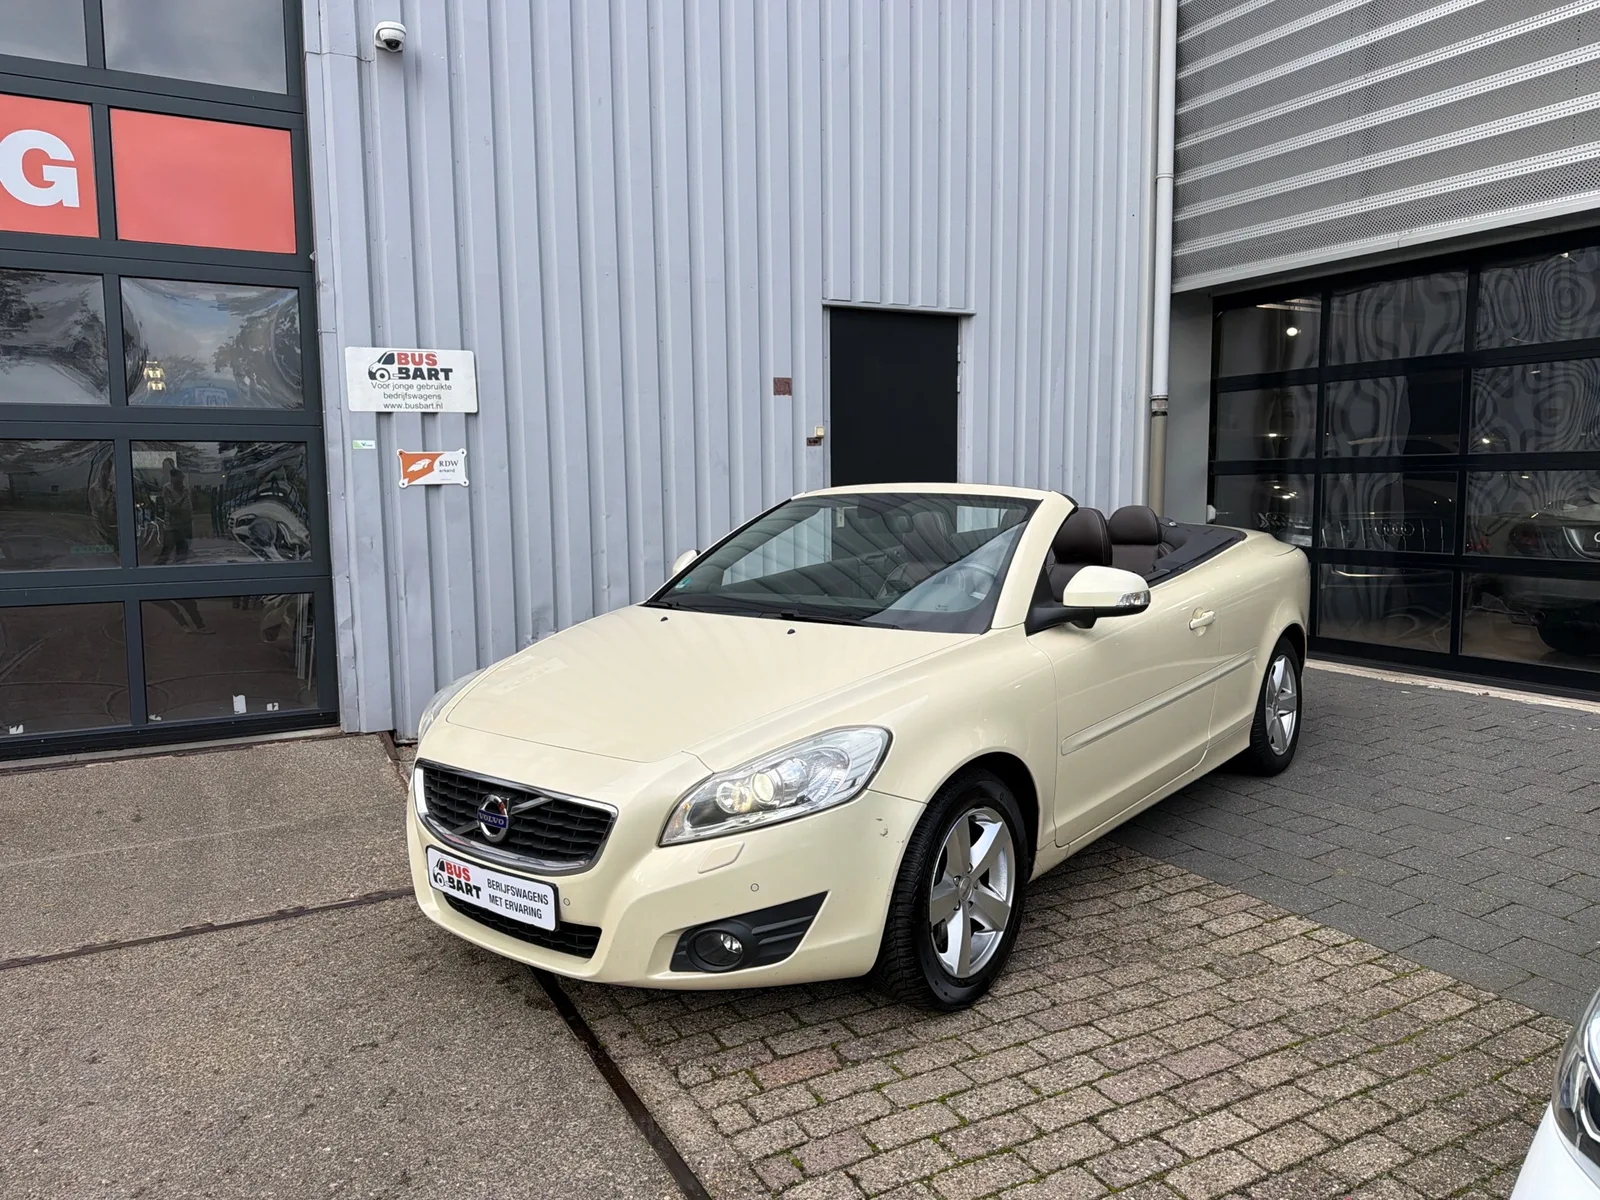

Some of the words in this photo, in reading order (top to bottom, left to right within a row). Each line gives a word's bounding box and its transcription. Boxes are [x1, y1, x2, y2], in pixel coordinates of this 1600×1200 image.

[0, 129, 80, 208] G
[396, 352, 438, 367] BUS
[397, 367, 453, 381] BART
[371, 382, 391, 390] Voor
[392, 382, 414, 391] jonge
[416, 382, 452, 391] gebruikte
[383, 392, 442, 401] bedrijfswagens
[383, 402, 443, 410] www.busbart.nl
[478, 812, 505, 826] VOLVO
[445, 861, 471, 882] BUS
[448, 877, 482, 900] BART
[487, 878, 549, 906] BERIJFSWAGENS
[488, 893, 503, 908] MET
[505, 897, 543, 920] ERVARING
